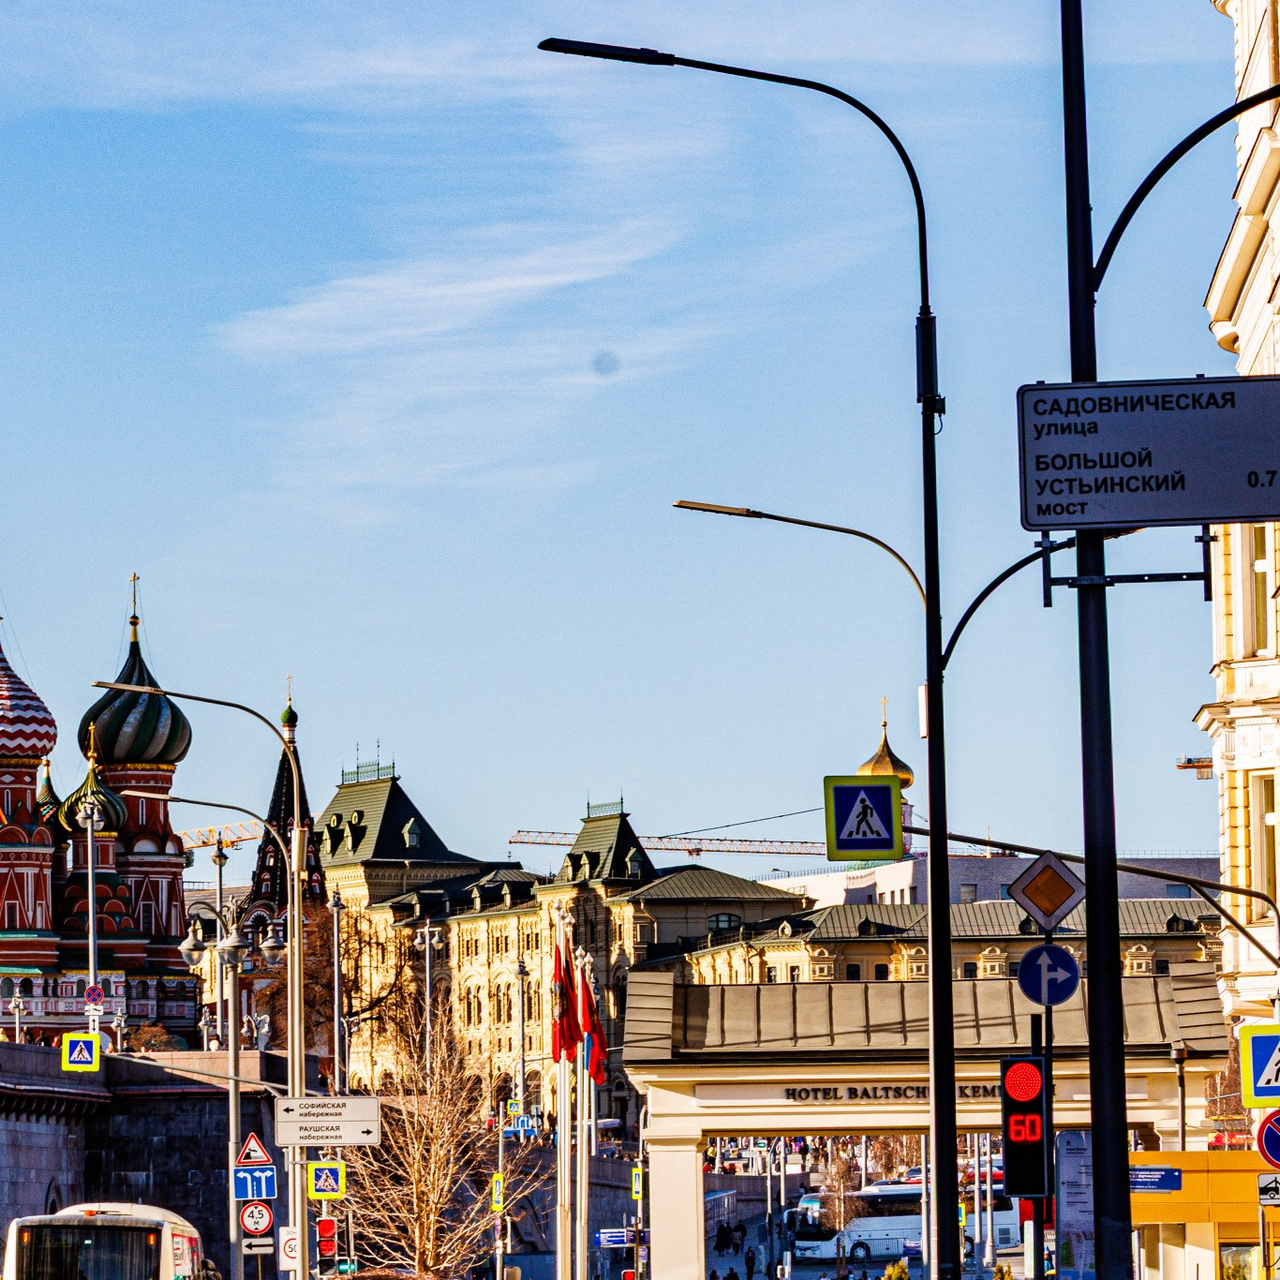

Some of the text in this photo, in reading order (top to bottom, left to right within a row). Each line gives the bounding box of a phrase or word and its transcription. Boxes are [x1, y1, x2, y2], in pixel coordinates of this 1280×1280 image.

[1033, 391, 1236, 418] САДОВНИЧЕСКАЯ
[1033, 420, 1099, 441] улица
[1035, 447, 1153, 472] БОЛЬШОЙ
[1035, 470, 1278, 496] УСТЬИНСКИЙ 0.7
[1036, 501, 1088, 517] мост
[785, 1087, 843, 1101] HOTEL
[848, 1085, 930, 1100] BALTSCH
[299, 1102, 346, 1110] СОФИЙСКАЯ
[1009, 1113, 1042, 1143] 60
[247, 1209, 264, 1221] 4,5
